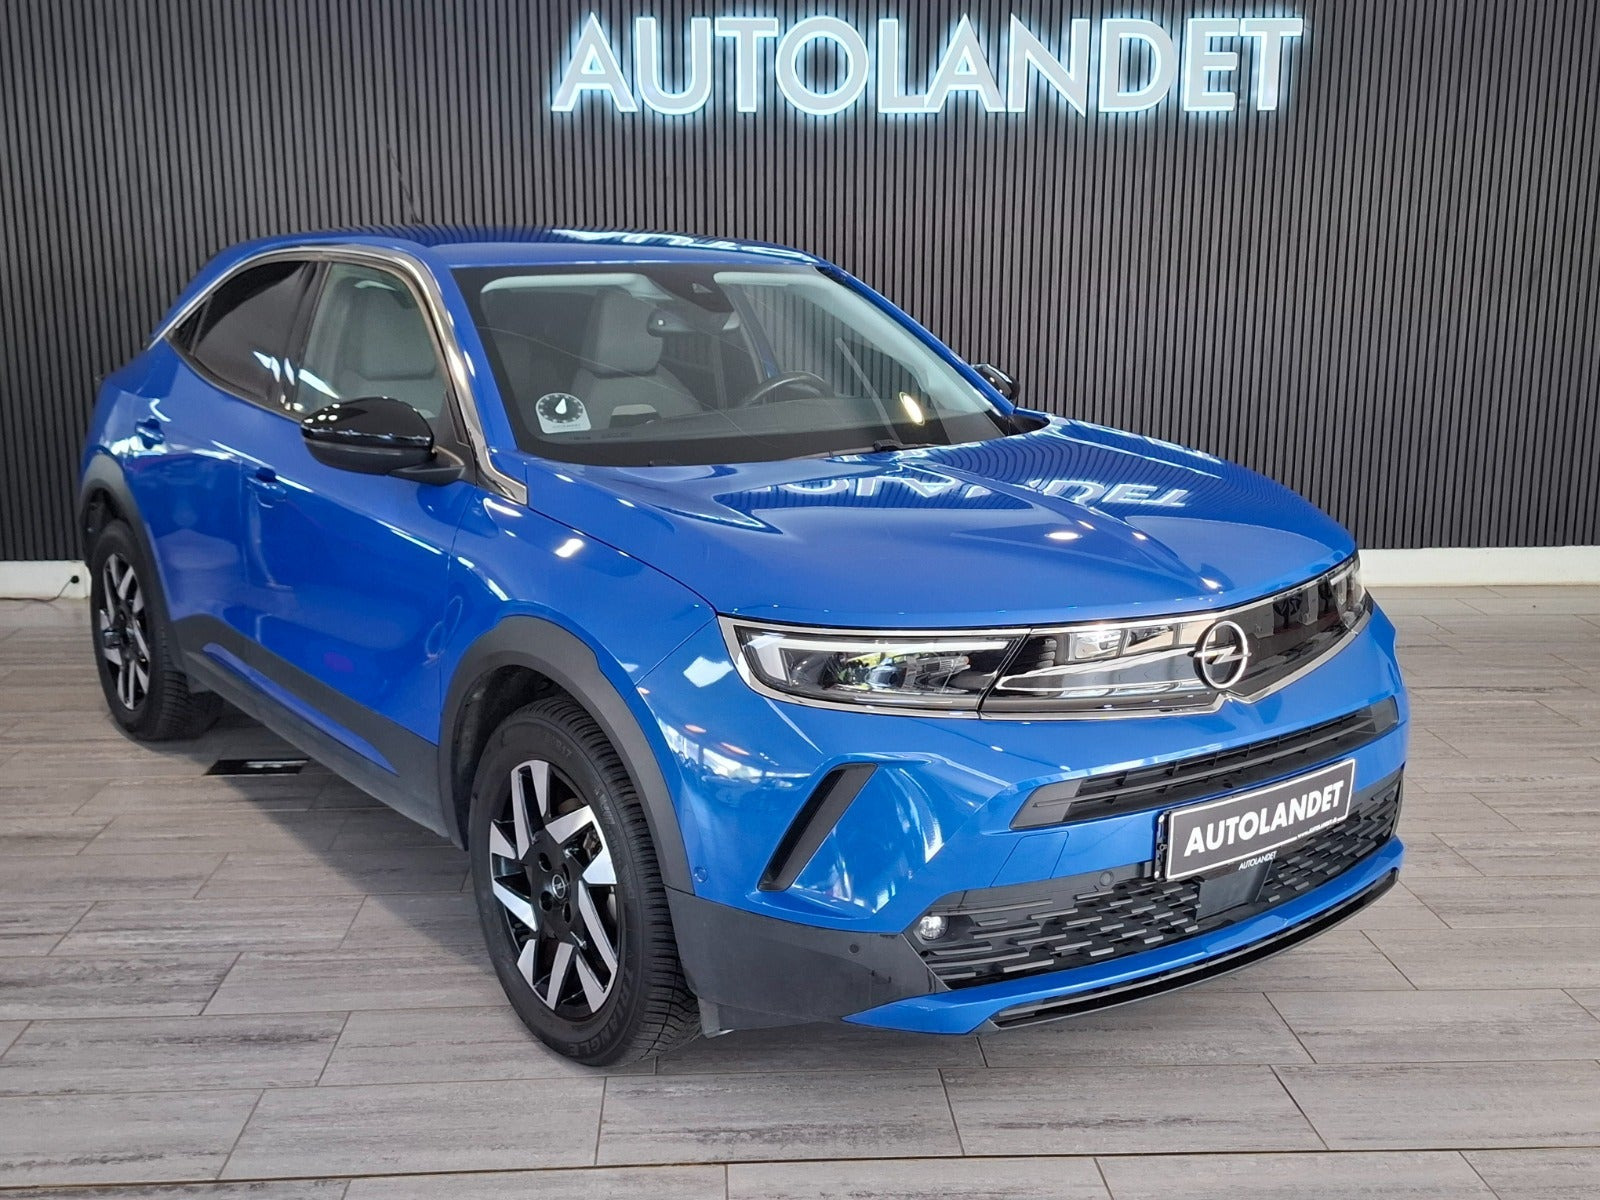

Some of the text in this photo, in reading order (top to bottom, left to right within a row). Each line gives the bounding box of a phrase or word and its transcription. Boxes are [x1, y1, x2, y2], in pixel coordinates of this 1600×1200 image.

[550, 12, 1304, 118] AUTOLANDET
[1183, 780, 1344, 857] AUTOLANDET
[1238, 850, 1278, 871] AUTOLANDET
